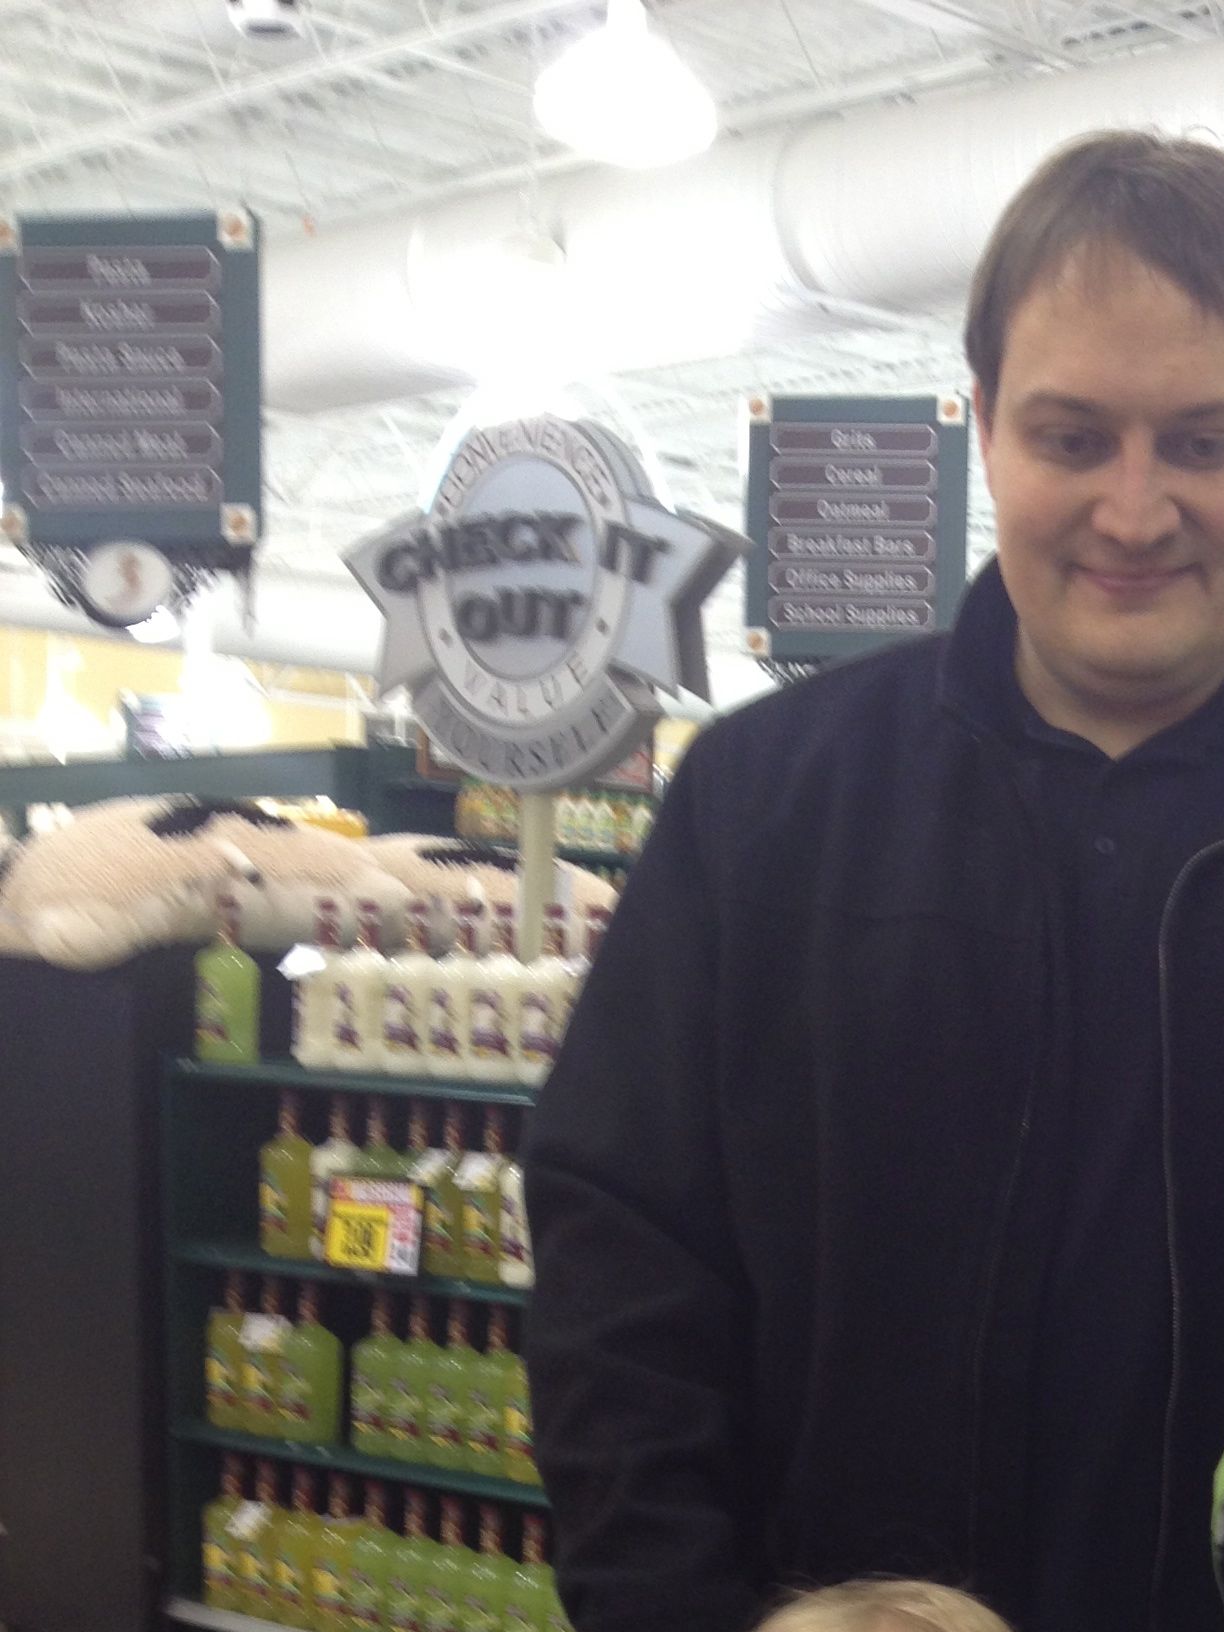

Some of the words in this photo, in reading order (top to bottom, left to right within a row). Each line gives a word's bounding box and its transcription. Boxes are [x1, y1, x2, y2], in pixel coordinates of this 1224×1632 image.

[831, 429, 876, 450] Grits
[825, 464, 882, 485] Cereal
[817, 500, 889, 522] Oatmeal
[374, 508, 585, 592] CHECK
[599, 517, 674, 586] IT
[787, 533, 873, 556] Breakfast
[874, 535, 915, 557] Bars
[785, 568, 842, 590] Office
[843, 569, 918, 594] Supplies
[456, 584, 587, 642] OUT
[784, 603, 844, 625] School
[846, 603, 920, 629] Supplies
